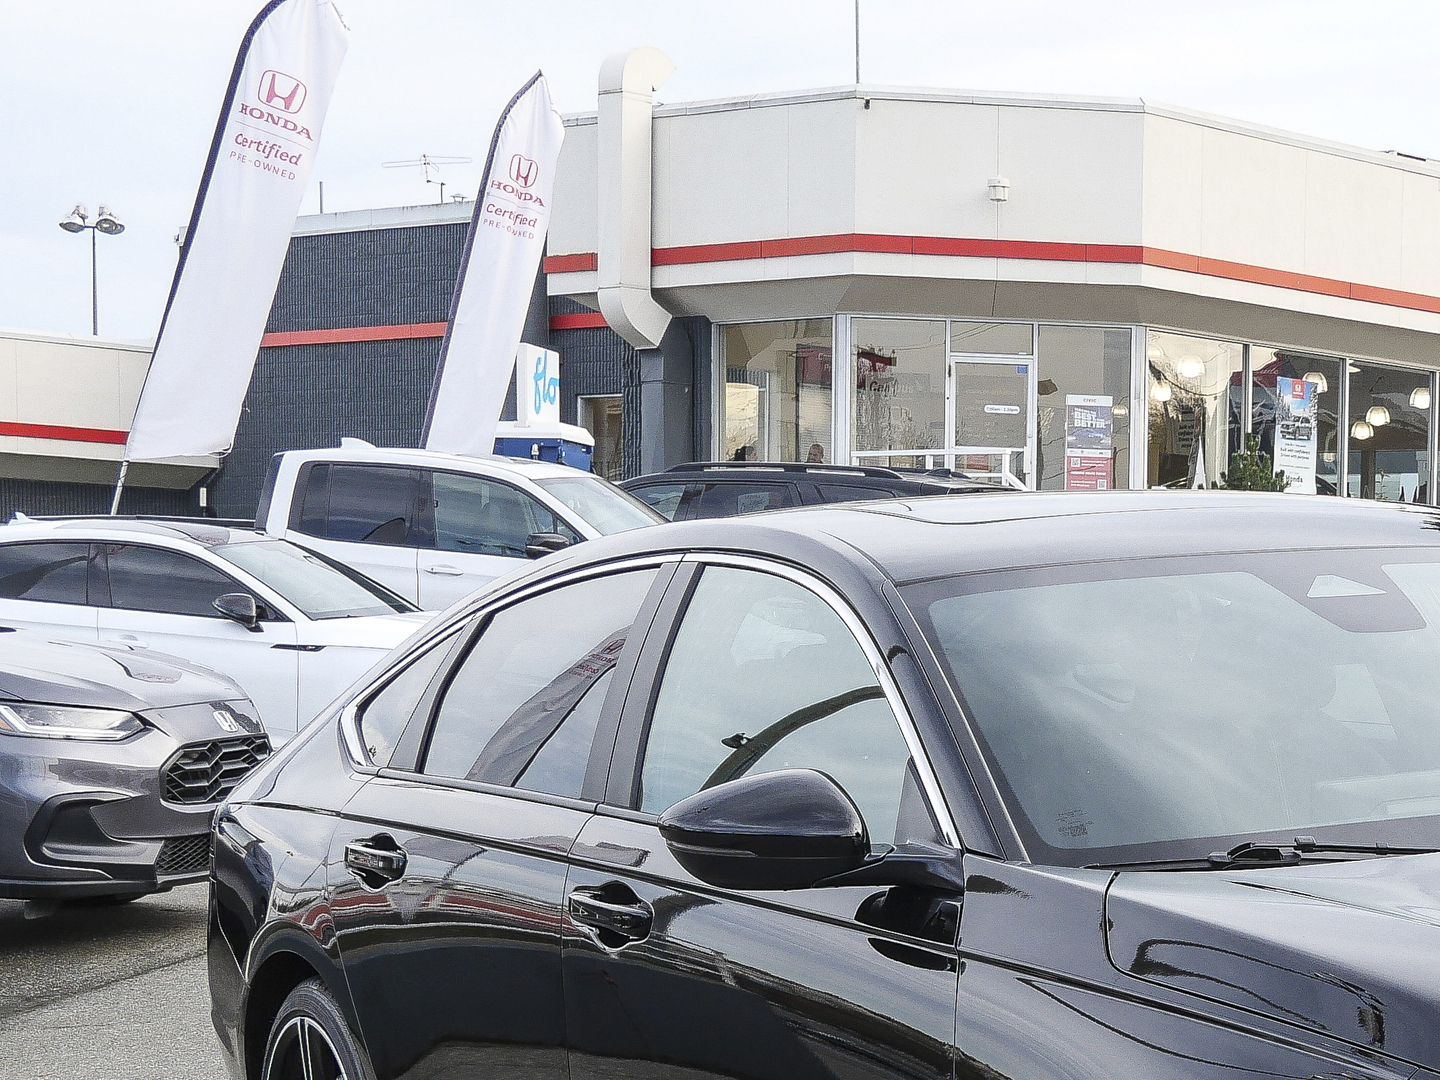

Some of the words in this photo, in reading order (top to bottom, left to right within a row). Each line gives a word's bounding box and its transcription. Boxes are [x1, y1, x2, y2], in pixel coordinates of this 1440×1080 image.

[239, 103, 314, 142] HONDA
[234, 133, 302, 166] Certified
[229, 151, 297, 181] PRE-OWNED
[490, 180, 546, 207] HONDA
[483, 218, 535, 240] PRE-OWNED
[486, 203, 538, 228] Certified
[533, 350, 561, 415] flo
